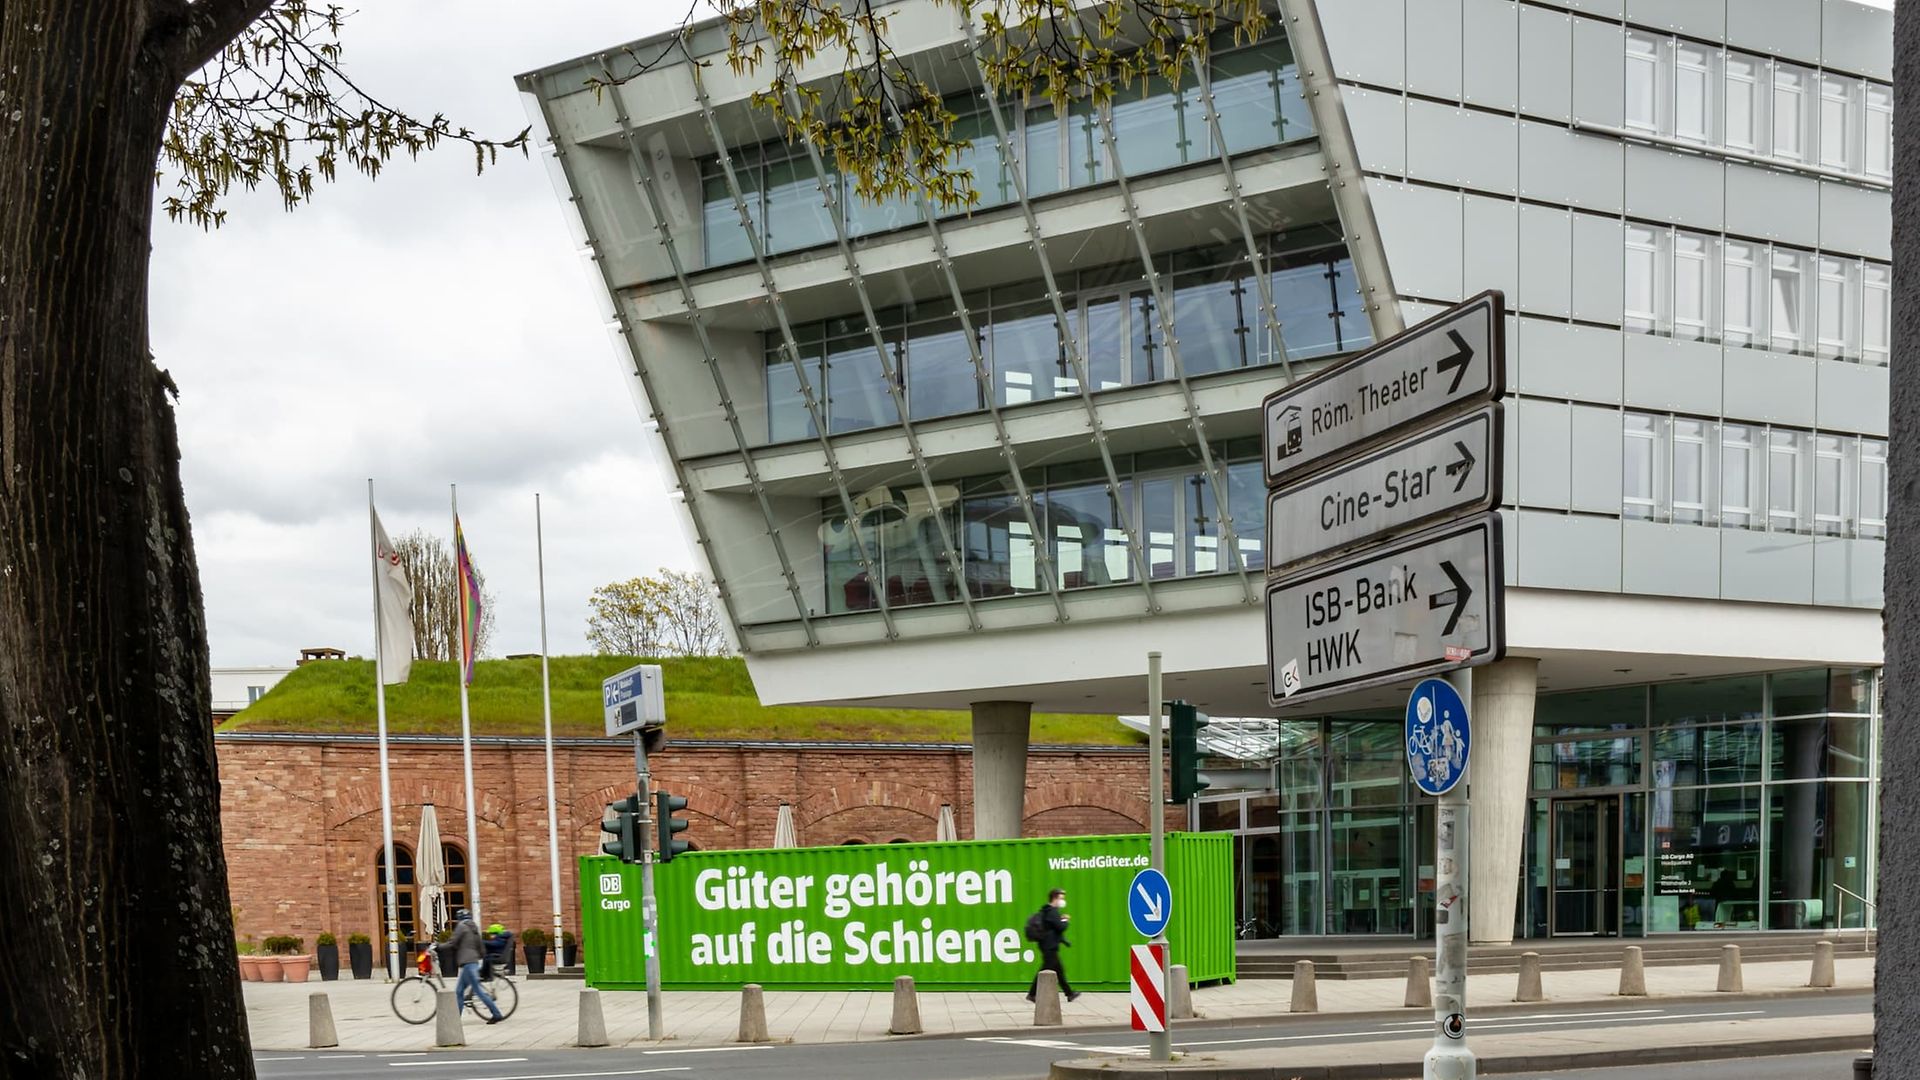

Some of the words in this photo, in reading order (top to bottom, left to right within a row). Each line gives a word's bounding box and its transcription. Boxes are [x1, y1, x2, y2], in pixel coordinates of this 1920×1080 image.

[1312, 402, 1353, 436] Röm.
[1358, 366, 1428, 415] Theater
[1320, 465, 1437, 531] Cine-Star
[1306, 565, 1417, 629] ISB-Bank
[1307, 629, 1361, 675] HWK
[602, 876, 620, 893] DB
[1048, 854, 1149, 870] WirSindGüter.de
[601, 898, 631, 911] Cargo
[694, 866, 814, 911] Güter
[824, 860, 1013, 919] gehören
[691, 921, 757, 965] auf
[767, 920, 832, 965] die
[844, 917, 1035, 965] Schiene.
